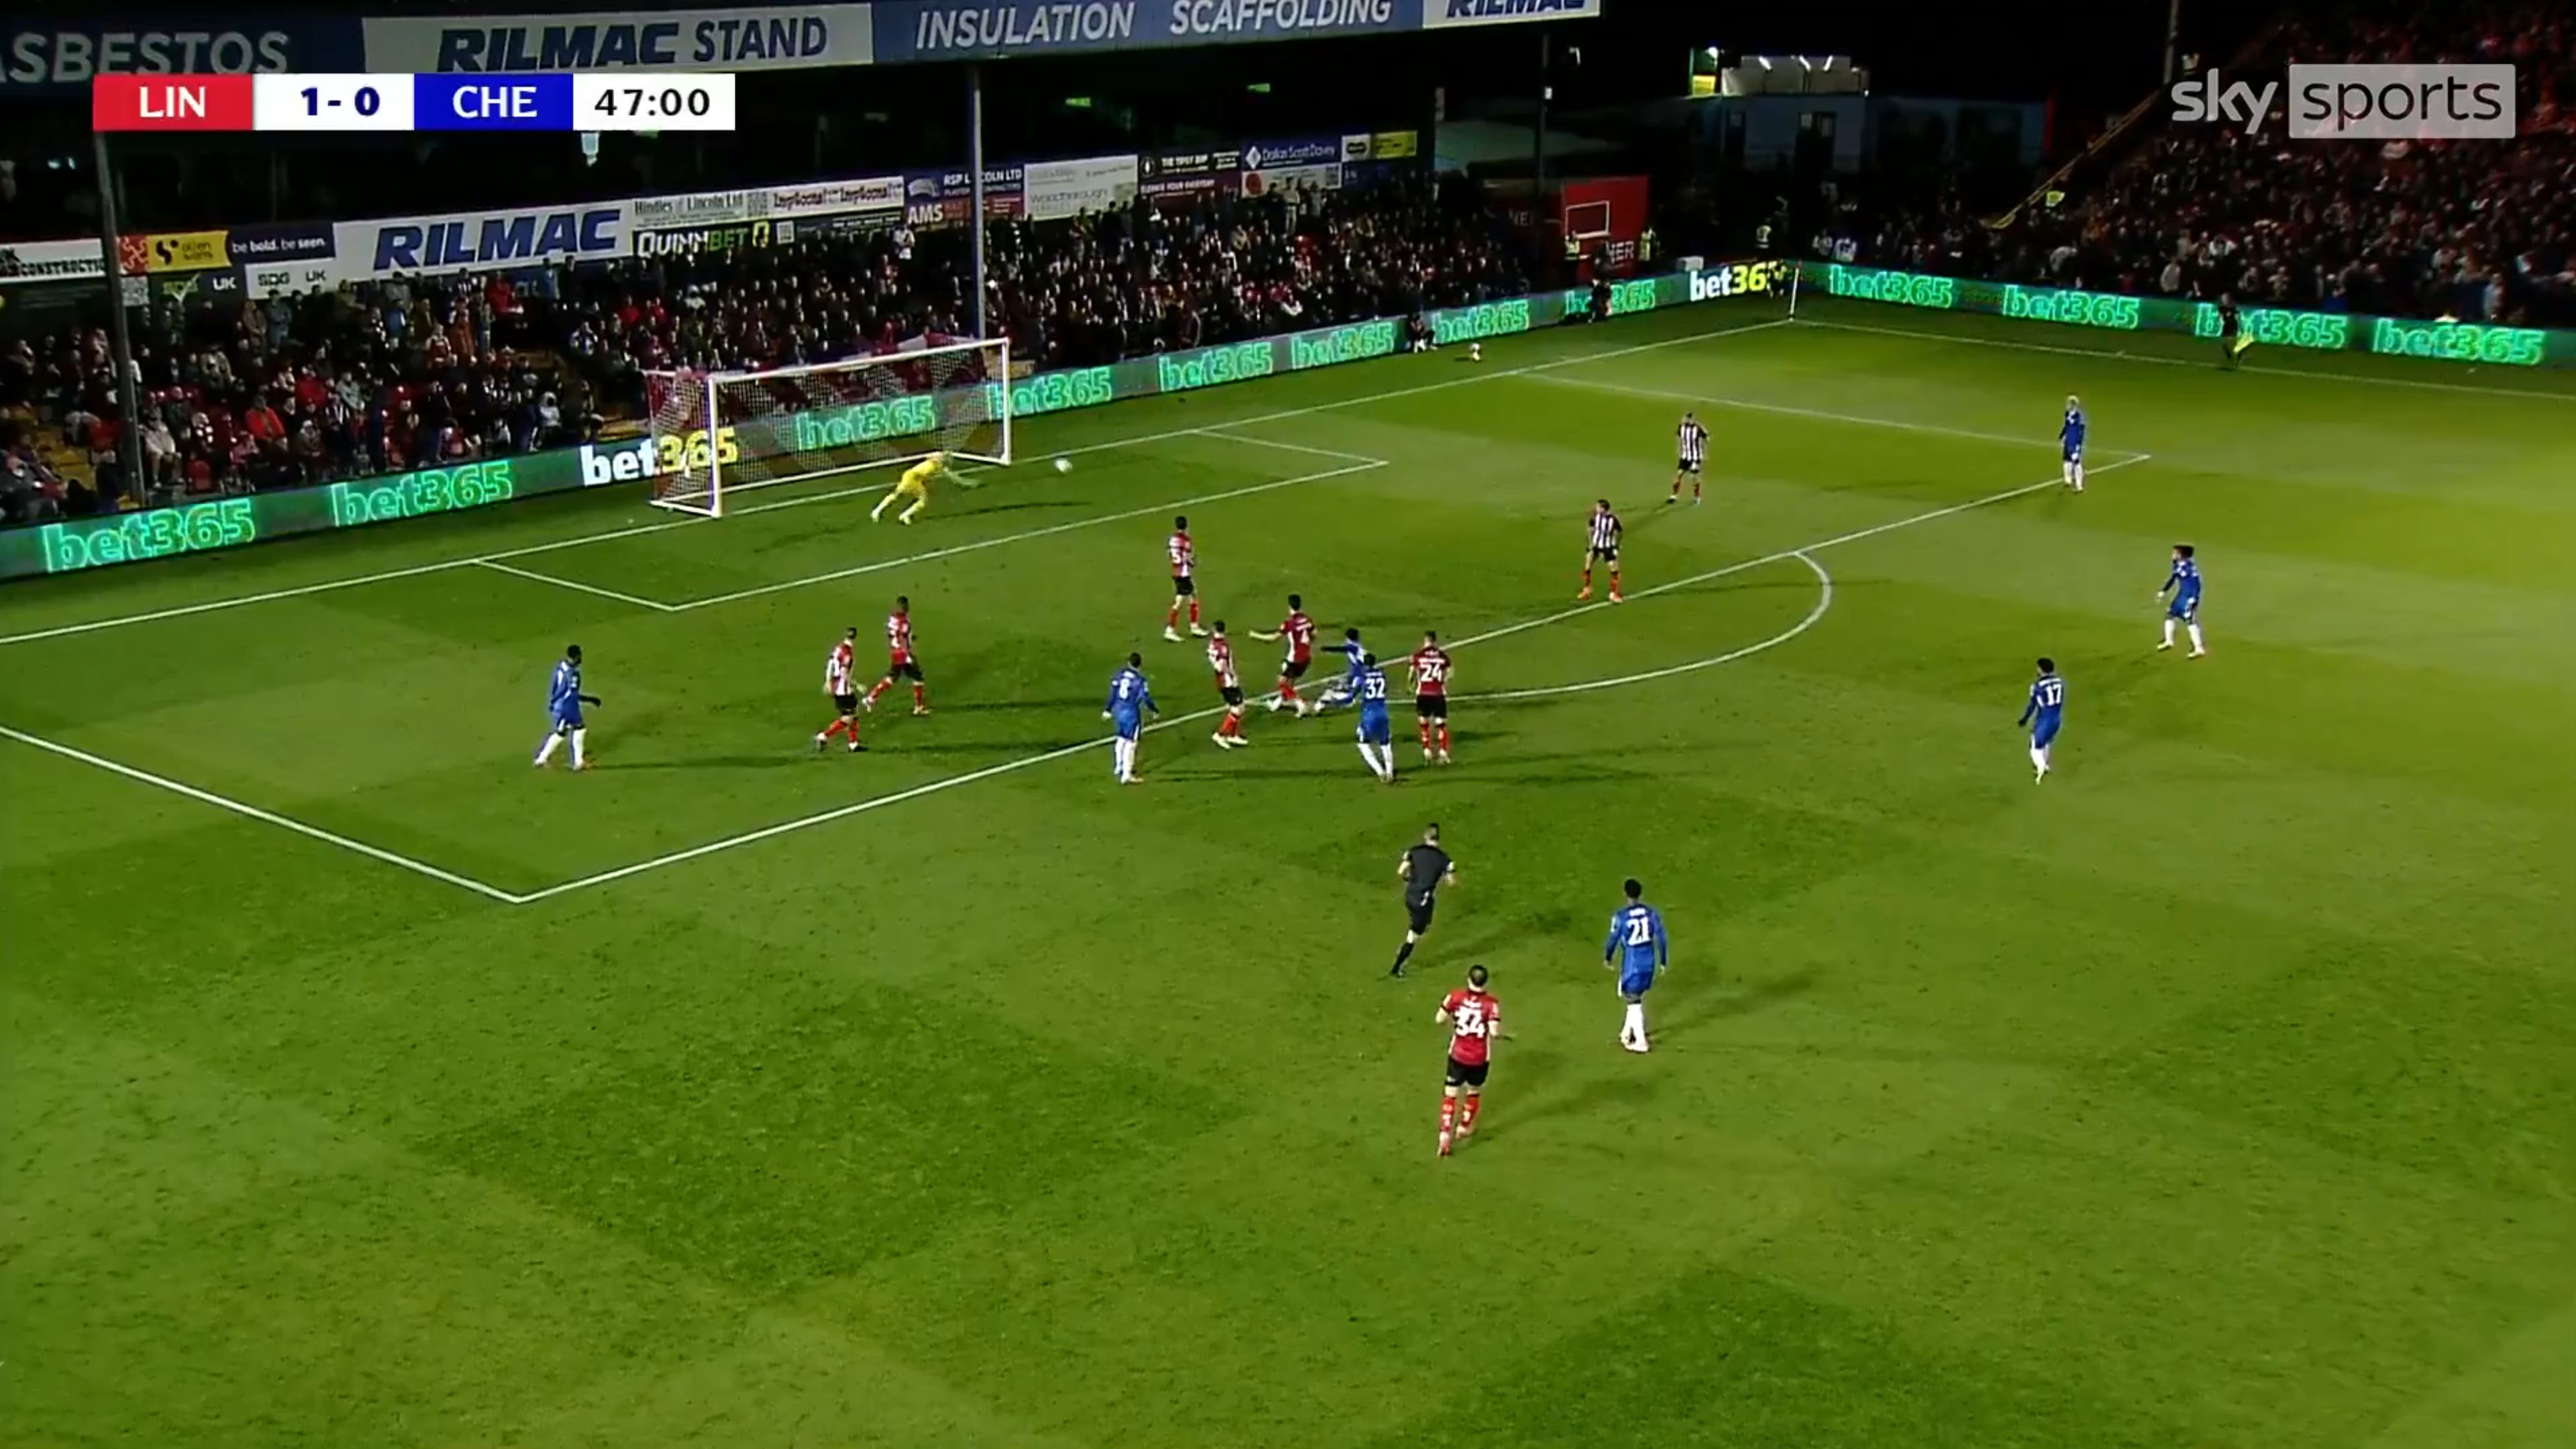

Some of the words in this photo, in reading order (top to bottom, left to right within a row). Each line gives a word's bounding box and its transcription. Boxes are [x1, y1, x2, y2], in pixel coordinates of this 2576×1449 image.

[916, 3, 1135, 50] INSULATION
[1170, 0, 1391, 35] SCAFFOLDING
[437, 21, 679, 72] RILMAC
[693, 17, 827, 61] STAND
[964, 170, 1004, 185] LCOLN
[907, 203, 943, 225] AMS
[232, 241, 248, 253] be
[281, 238, 296, 250] be
[373, 209, 621, 270] RILMAC
[213, 277, 237, 291] UK
[305, 269, 327, 283] UK
[1830, 264, 1953, 308] bet365
[1431, 299, 1531, 344] bet365
[2003, 284, 2141, 330] bet365
[2195, 303, 2348, 349] bt365
[1292, 321, 1394, 370] bet365
[2373, 317, 2546, 366] bet365
[1158, 341, 1274, 392] bet365
[986, 366, 1113, 421] bet365
[794, 395, 937, 450] bet365
[580, 426, 739, 486] bet365
[331, 460, 513, 528] bet365
[42, 498, 256, 573] bet365
[1119, 678, 1131, 699] 8
[1366, 678, 1386, 699] 32
[1420, 663, 1443, 683] 24
[2047, 683, 2061, 705] 17
[1627, 917, 1651, 946] 21
[1453, 1007, 1486, 1038] 34
